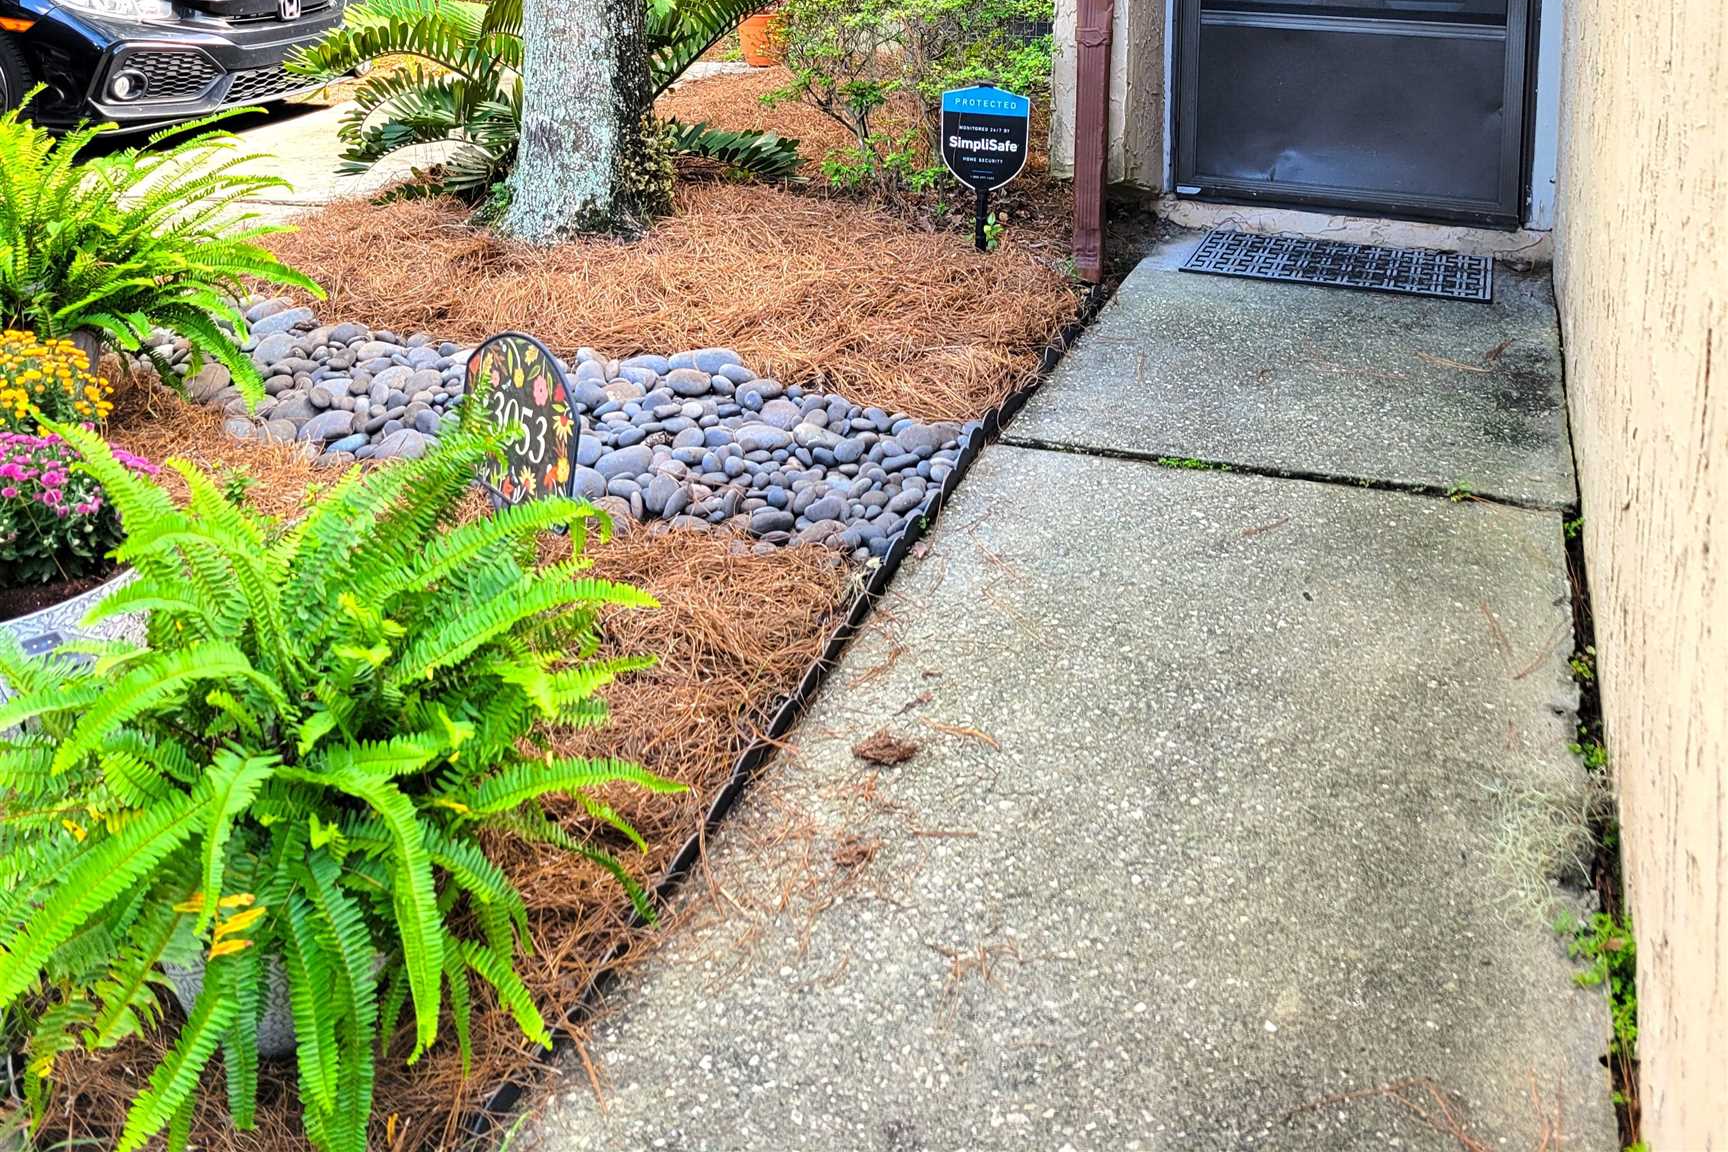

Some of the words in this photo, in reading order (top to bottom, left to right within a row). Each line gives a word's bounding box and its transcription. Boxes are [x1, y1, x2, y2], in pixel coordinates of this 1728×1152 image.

[954, 97, 1017, 110] PROTECTED
[949, 135, 1018, 152] SimpliSafe
[978, 156, 1003, 164] SECURITY
[489, 391, 548, 464] 3053
